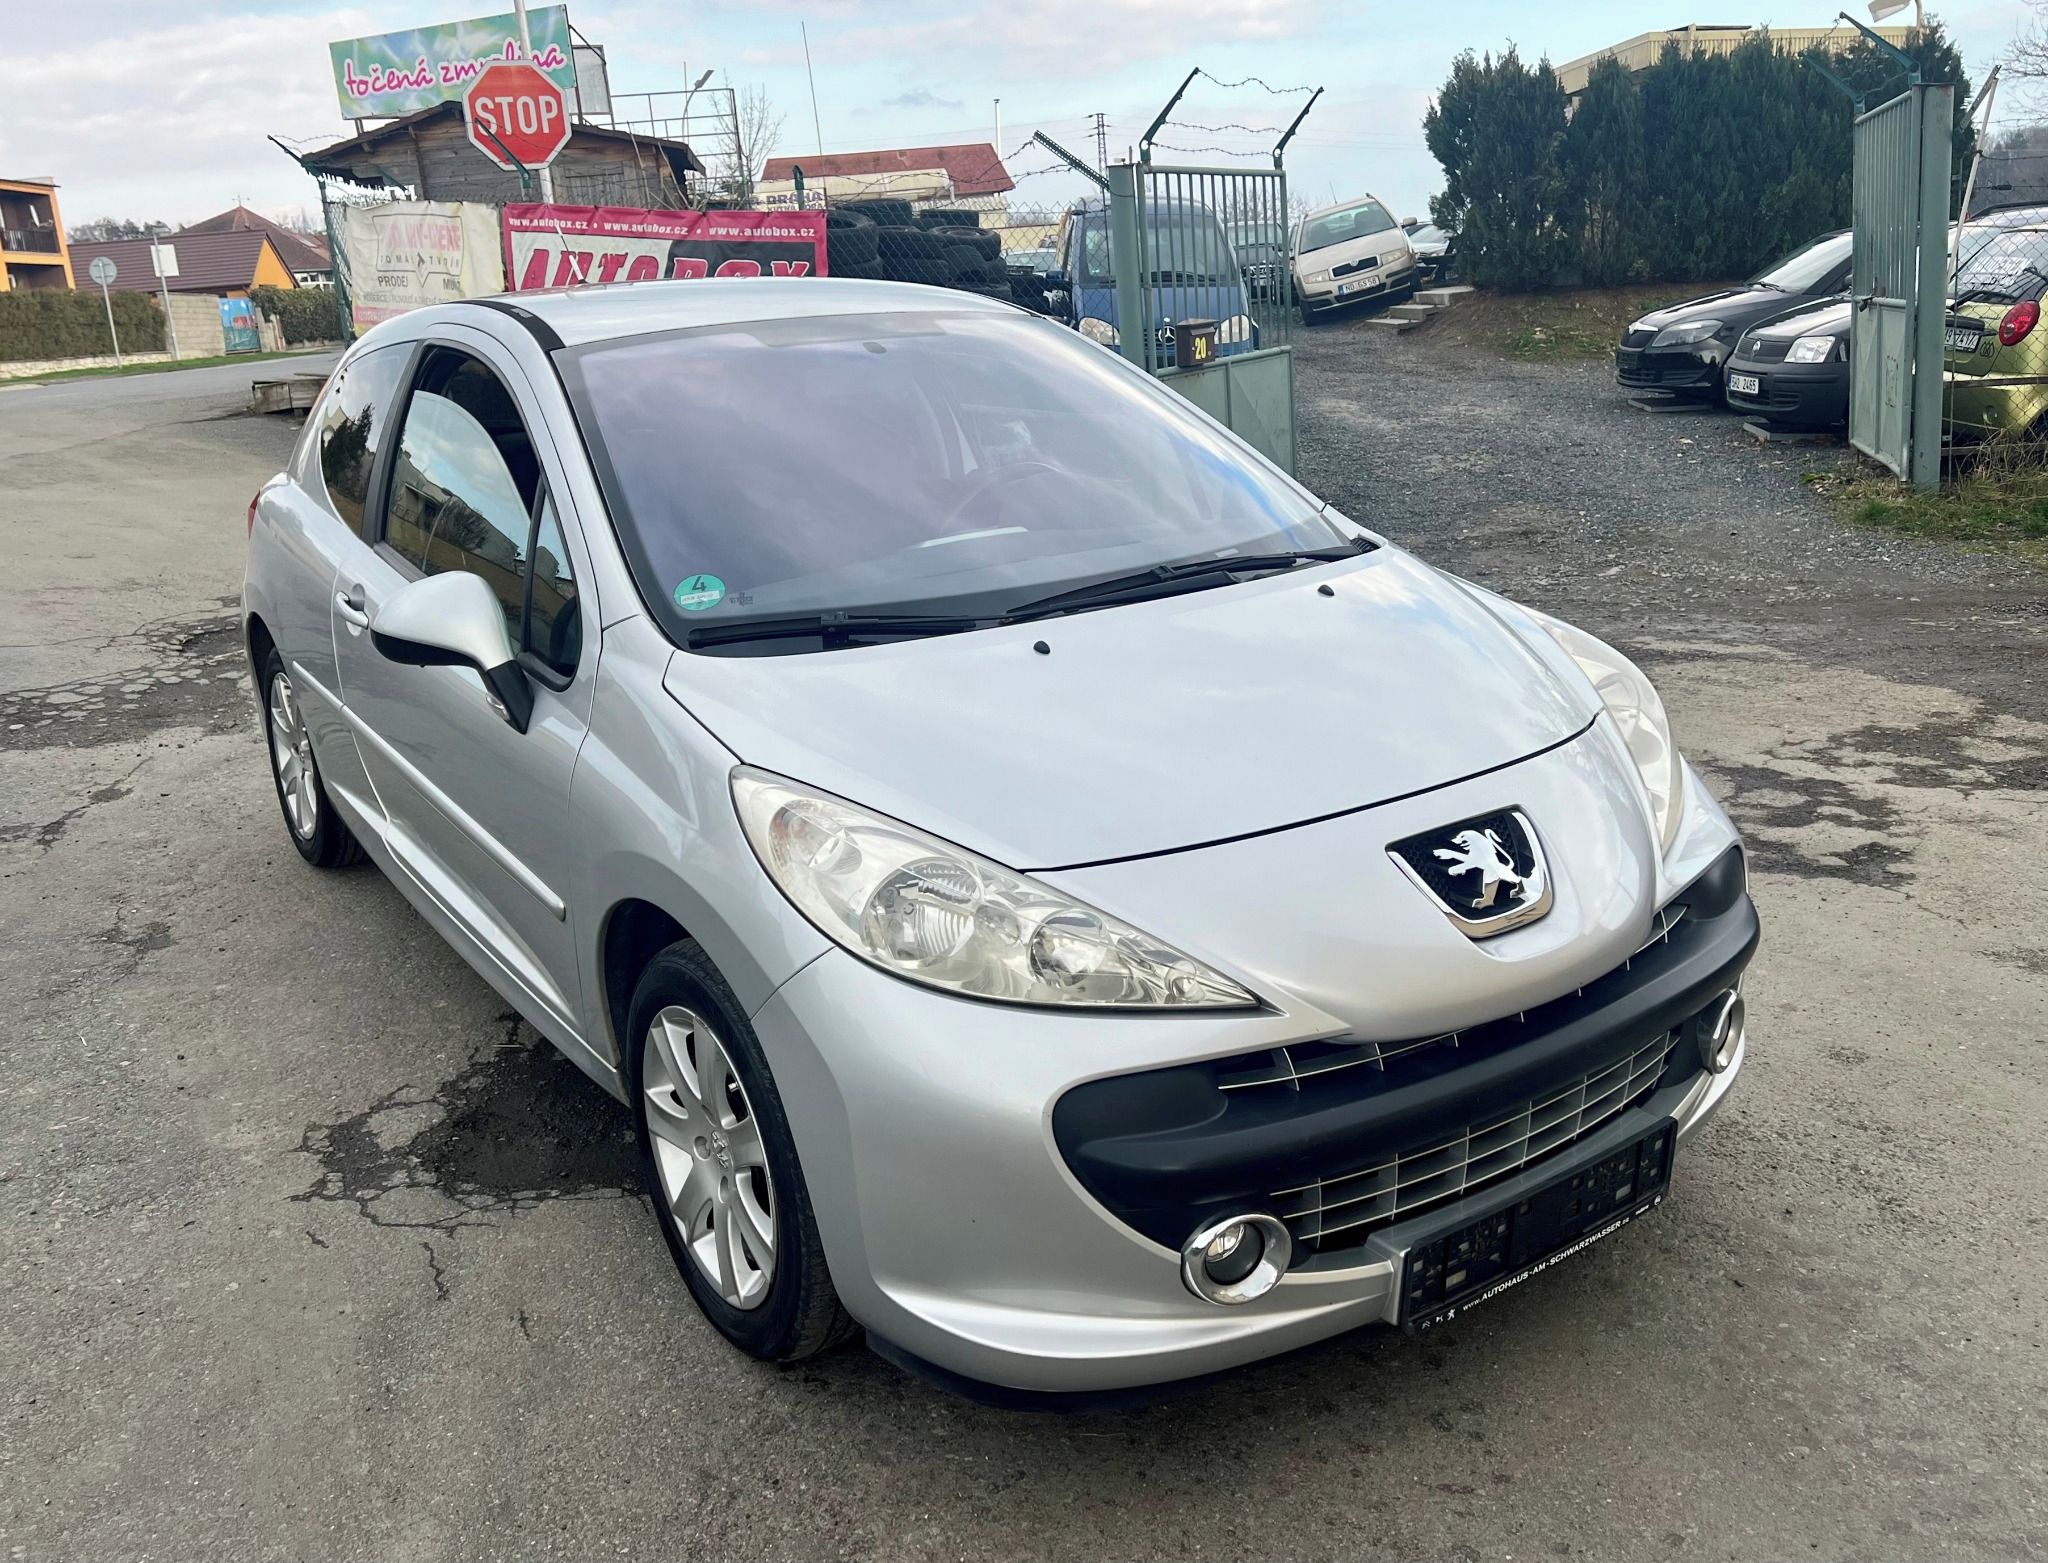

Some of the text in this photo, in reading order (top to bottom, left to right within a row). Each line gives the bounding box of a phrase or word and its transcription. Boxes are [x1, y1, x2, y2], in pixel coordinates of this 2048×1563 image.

[346, 59, 433, 96] točená
[474, 95, 558, 137] STOP
[604, 222, 689, 235] www.autobox.cz
[709, 226, 816, 237] www.autobox.cz
[377, 275, 408, 288] PRODEJ
[1195, 336, 1207, 360] 20
[692, 575, 706, 592] 4
